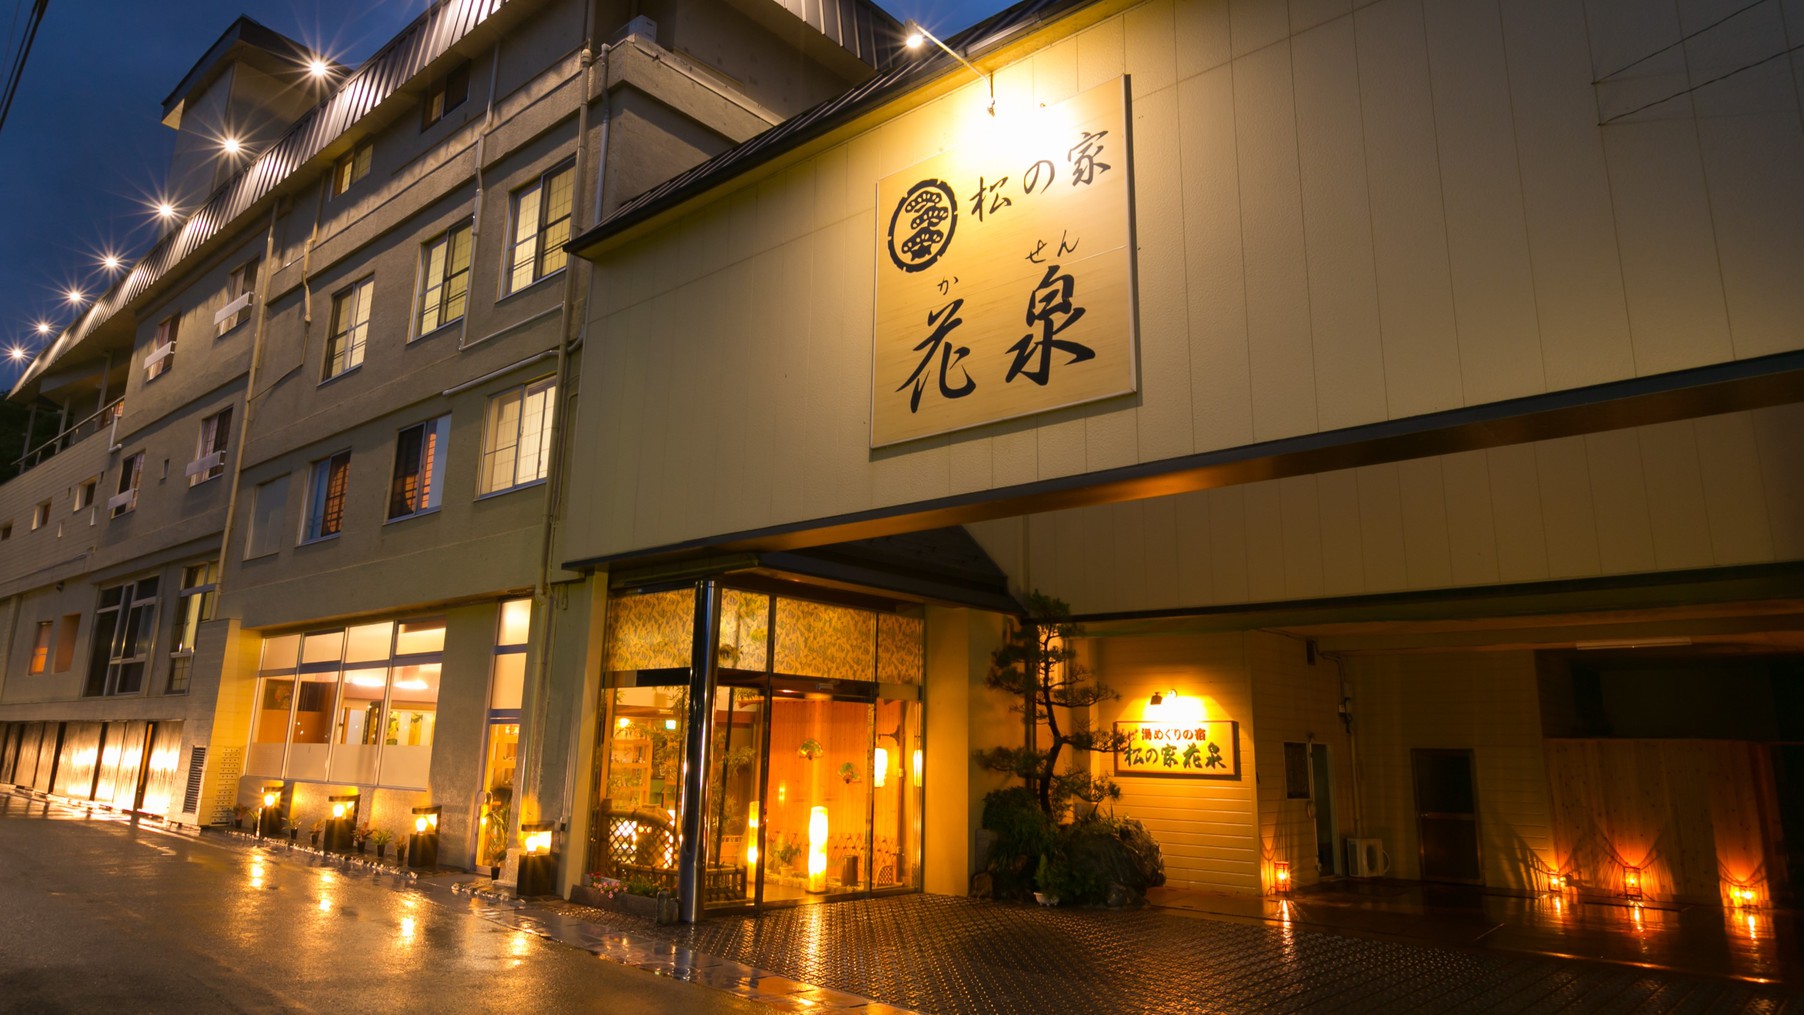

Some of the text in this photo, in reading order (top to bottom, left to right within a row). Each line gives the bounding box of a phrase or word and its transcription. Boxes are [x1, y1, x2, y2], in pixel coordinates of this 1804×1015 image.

[969, 129, 1112, 223] 松の家
[936, 229, 1081, 297] か せん
[895, 265, 1096, 414] 花泉
[1123, 741, 1228, 770] 松の家花泉
[1141, 727, 1207, 741] 湯めぐりの宿
